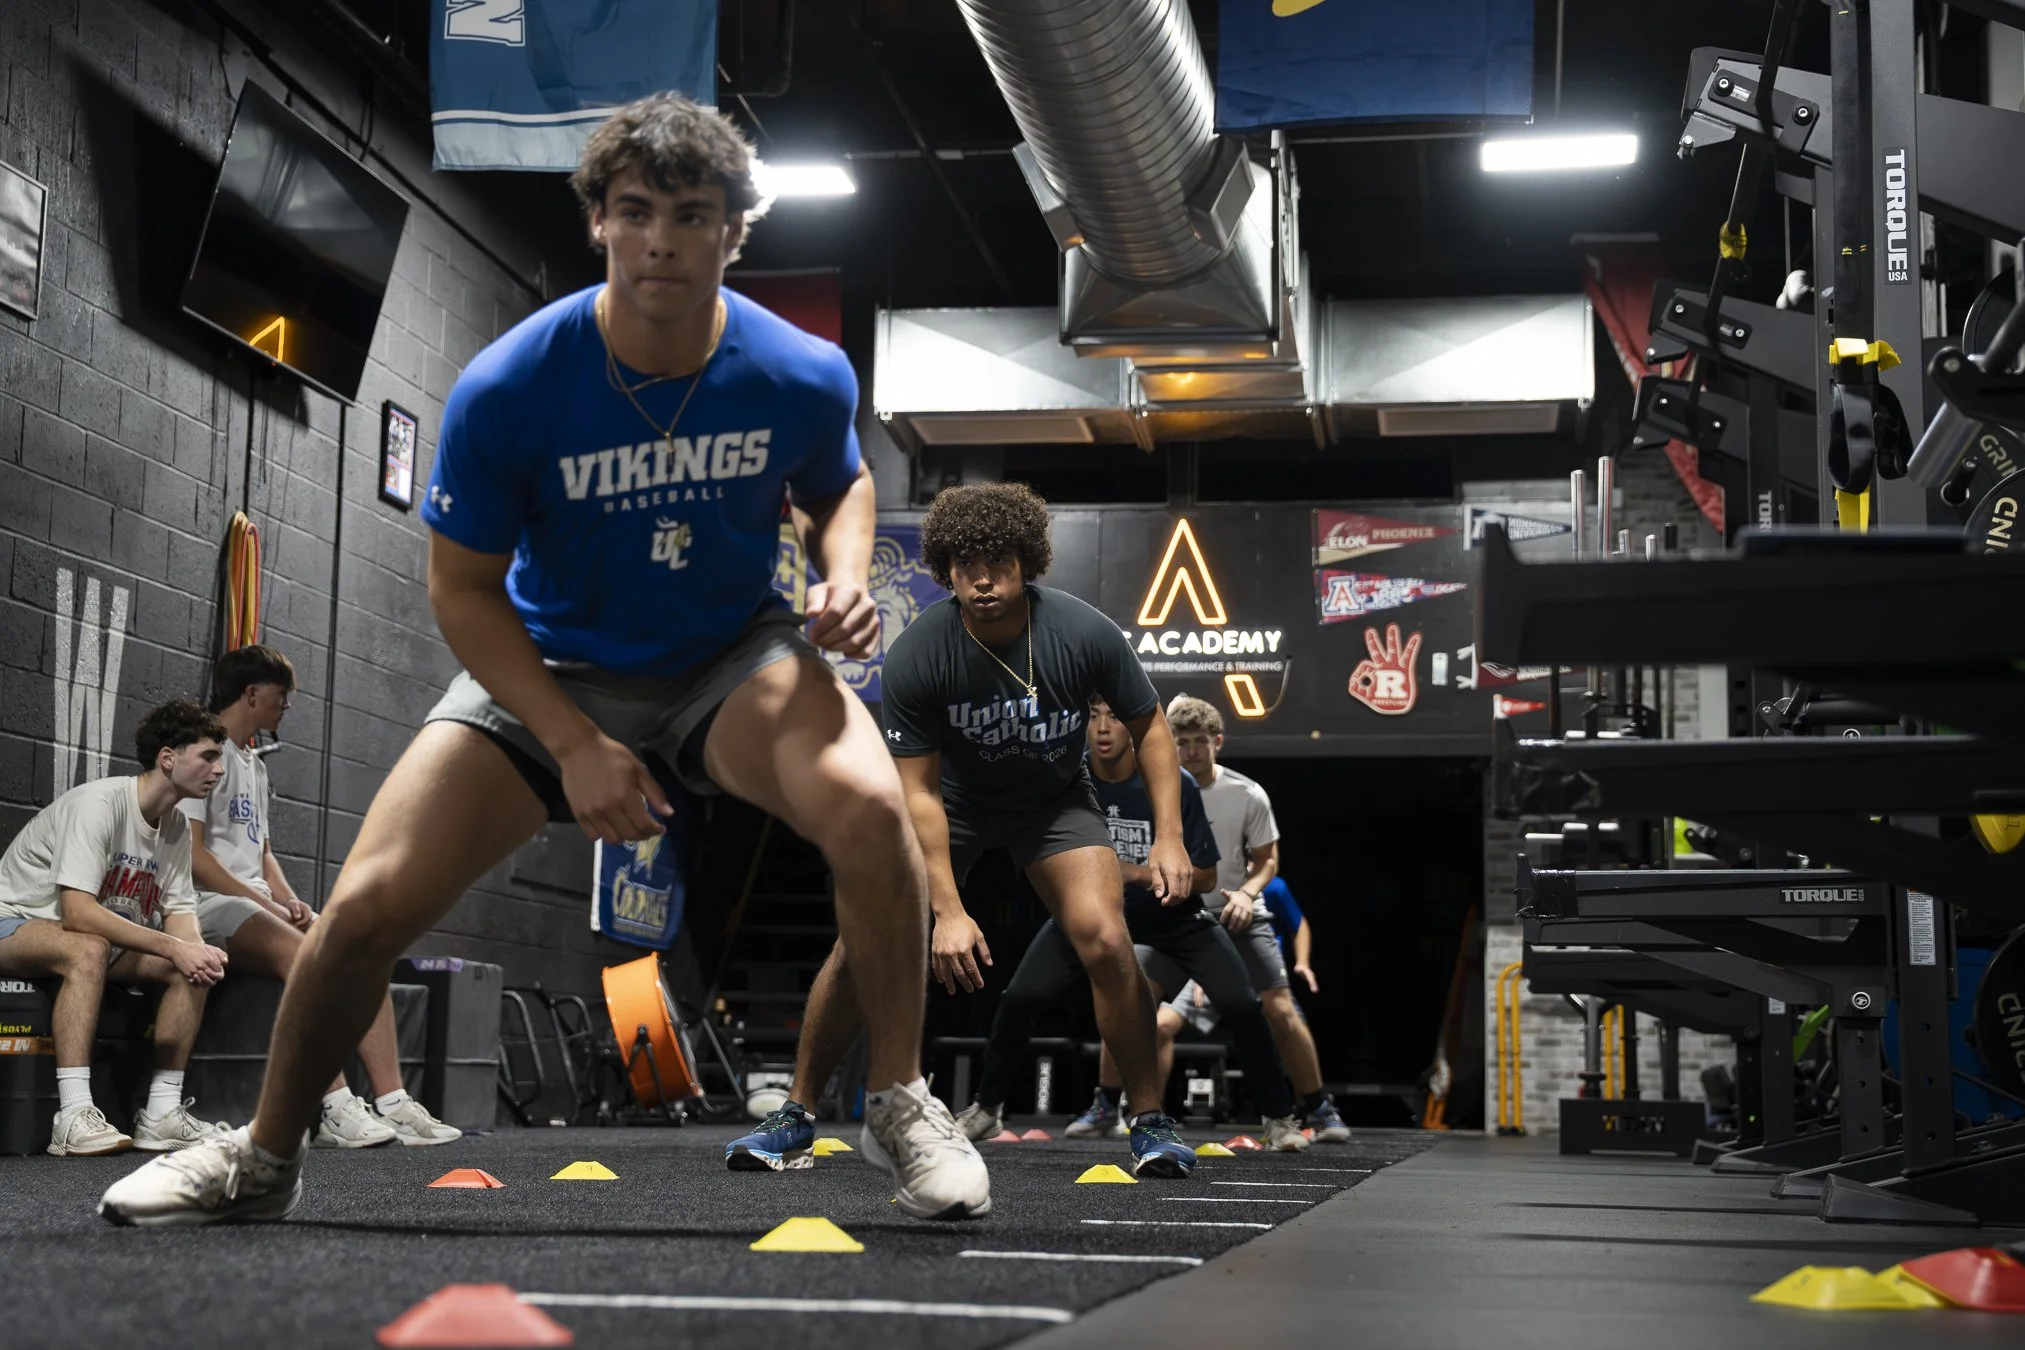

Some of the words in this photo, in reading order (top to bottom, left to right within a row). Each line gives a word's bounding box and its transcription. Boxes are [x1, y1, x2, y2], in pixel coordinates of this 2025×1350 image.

[1885, 148, 1908, 271] TORQUE
[1888, 271, 1908, 281] USA
[559, 428, 772, 499] VIKINGS
[604, 486, 724, 513] BASEBALL
[1328, 535, 1369, 549] ELON
[1372, 527, 1435, 541] PHOENIX
[1323, 577, 1365, 616] A
[1137, 630, 1282, 656] ACADEMY
[1153, 661, 1225, 672] PERFORMANCE
[1234, 661, 1283, 672] TRAINING
[1374, 670, 1409, 699] R
[948, 695, 1039, 729] Union
[962, 709, 1082, 746] Catholic
[979, 745, 1021, 762] CLASS
[1022, 748, 1042, 760] OF
[1042, 745, 1068, 763] 2026
[1781, 889, 1857, 902] TORQUE
[0, 981, 36, 993] TOR
[1037, 1061, 1052, 1111] ROGUE
